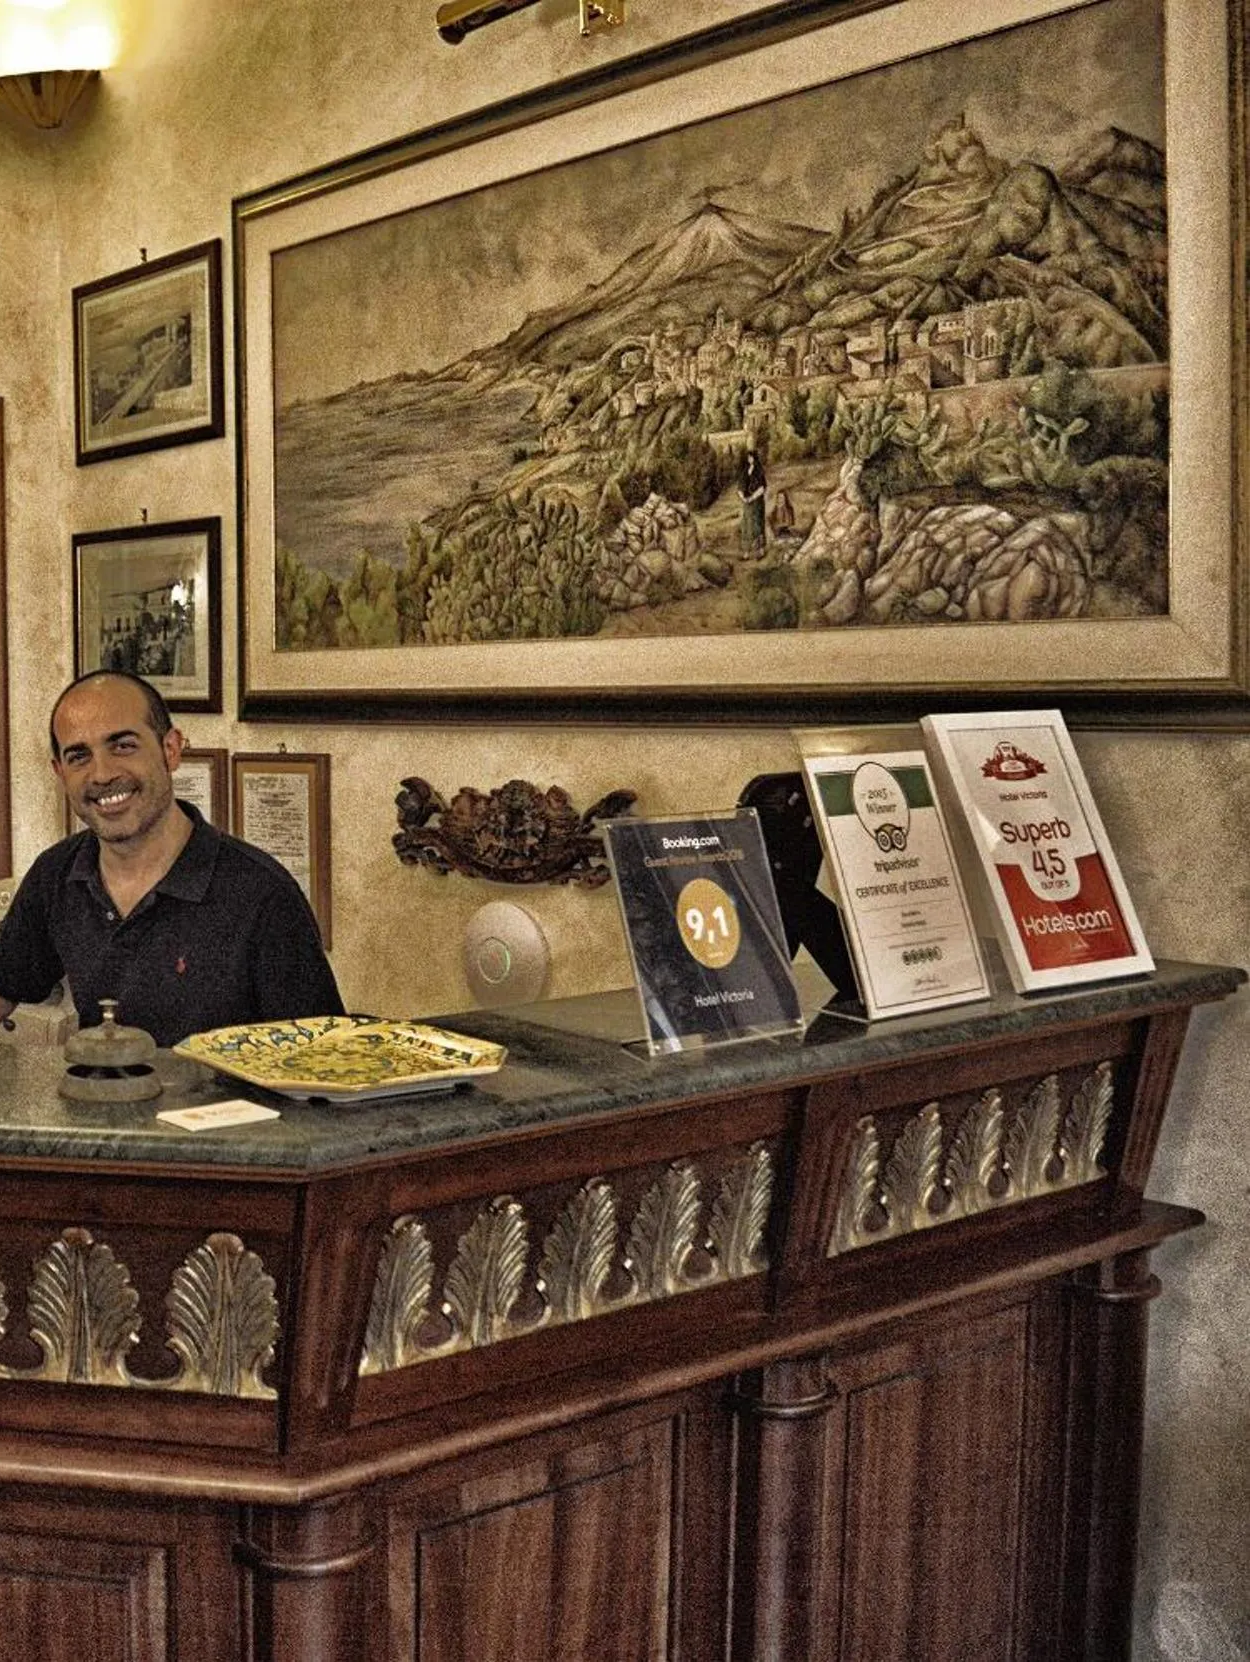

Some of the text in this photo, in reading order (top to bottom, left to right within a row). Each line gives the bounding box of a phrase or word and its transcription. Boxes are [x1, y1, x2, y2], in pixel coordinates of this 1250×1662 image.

[662, 835, 720, 850] Booking.com
[1000, 816, 1071, 847] Superb
[856, 883, 899, 898] CERTIFICATE
[909, 876, 950, 892] EXCELLENCE
[1021, 909, 1113, 938] Hotels.com
[694, 988, 755, 1007] Hotel Victoria
